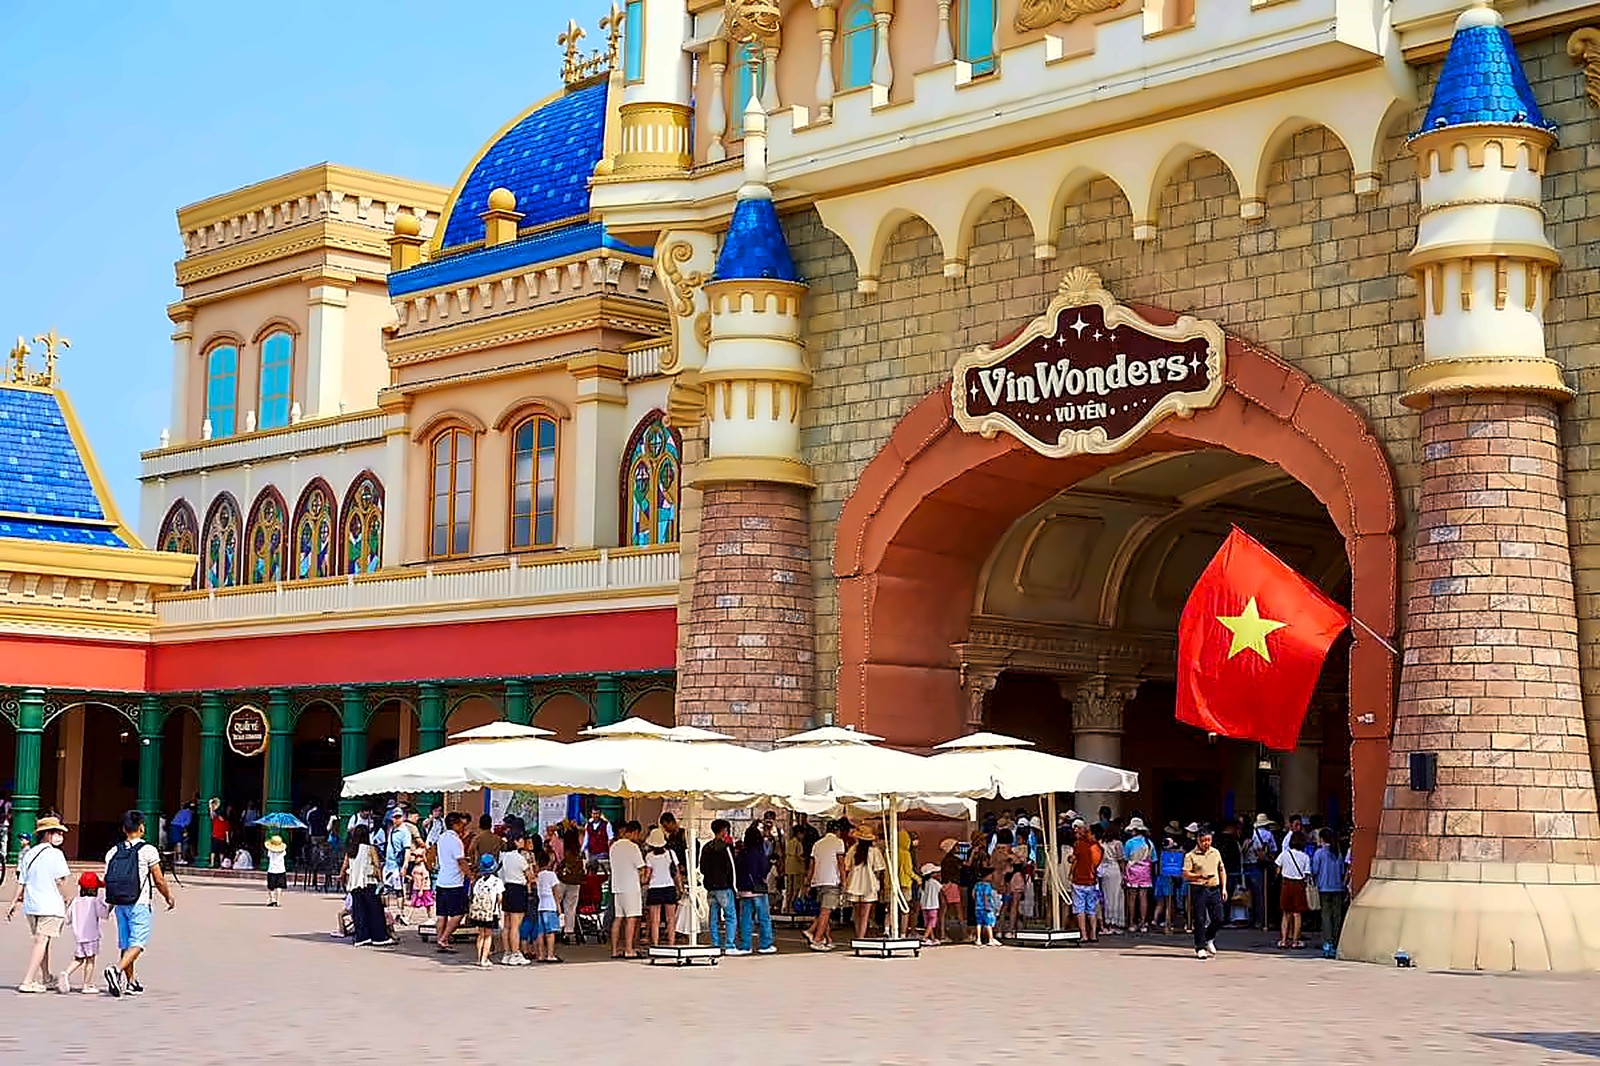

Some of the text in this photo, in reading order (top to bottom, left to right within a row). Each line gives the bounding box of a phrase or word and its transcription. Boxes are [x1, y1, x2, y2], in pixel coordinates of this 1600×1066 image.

[979, 354, 1189, 406] VinWonders
[1054, 400, 1107, 422] VŨ YÊN
